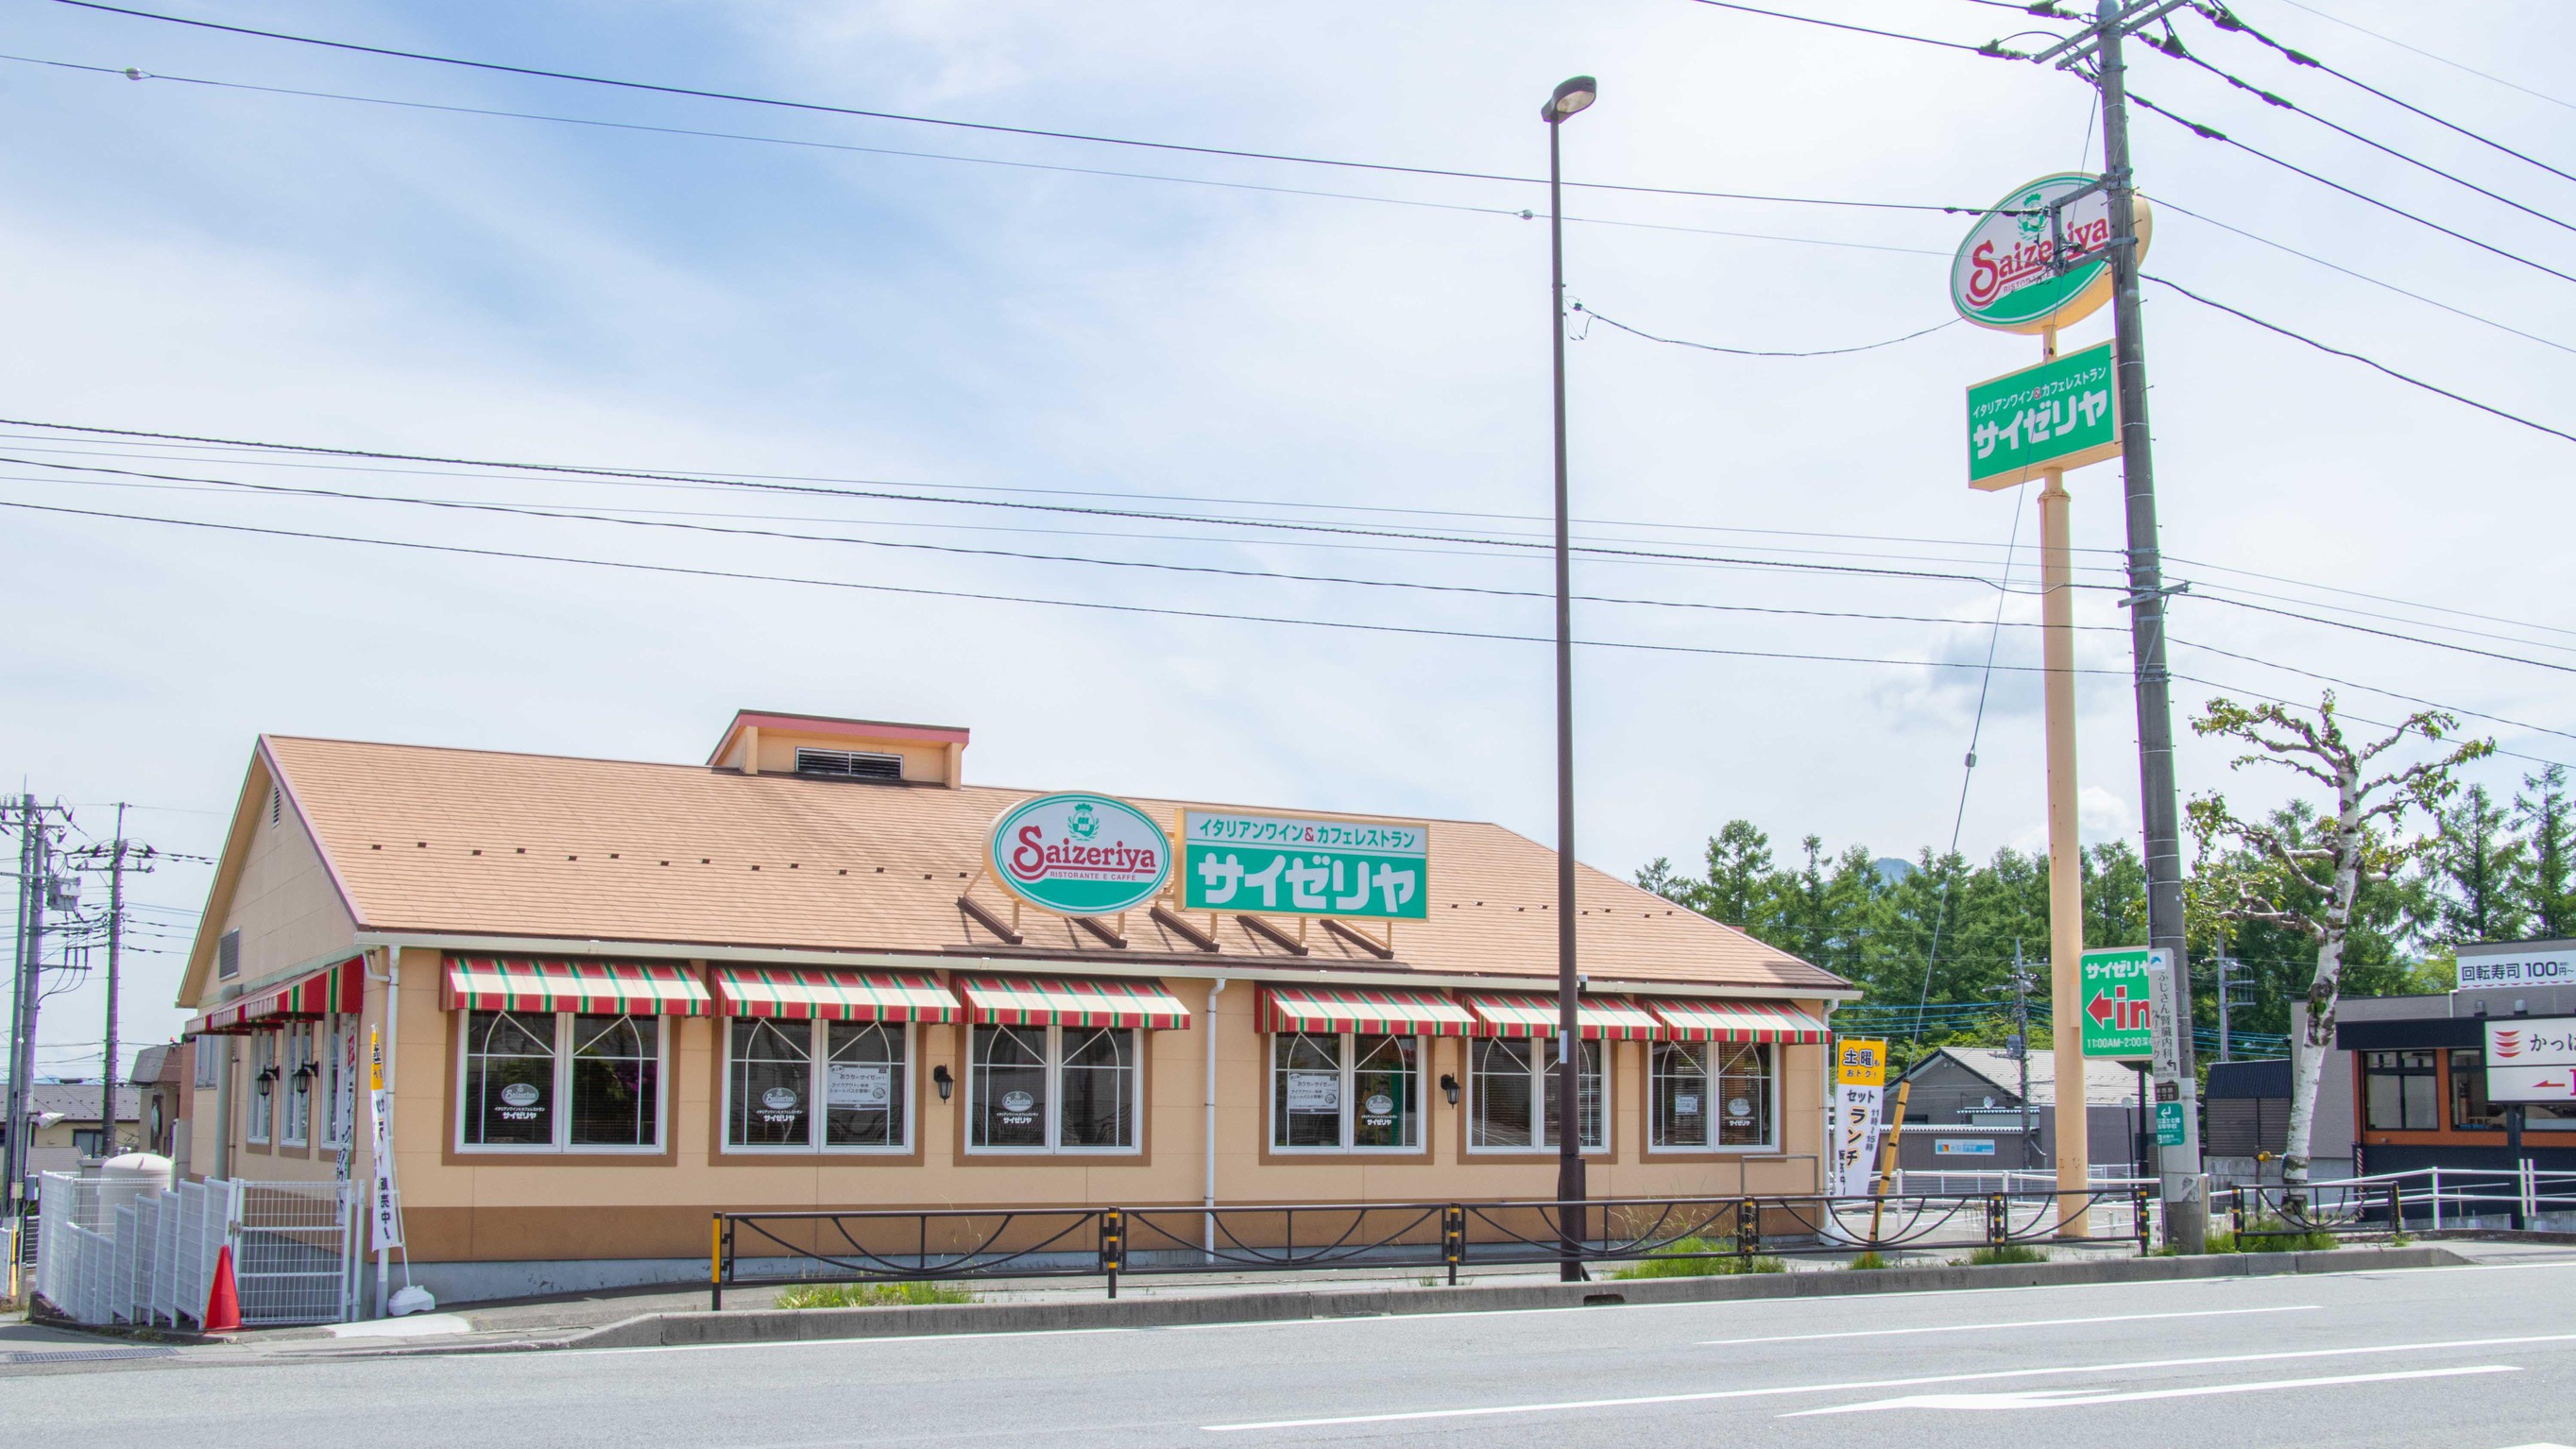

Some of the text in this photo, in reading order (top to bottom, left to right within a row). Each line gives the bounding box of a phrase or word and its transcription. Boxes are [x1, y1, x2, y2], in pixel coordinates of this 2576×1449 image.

[1968, 218, 2108, 303] Saizeiya
[1973, 367, 2107, 418] イタリアンワイン&カフェレストラン
[1973, 389, 2107, 460] サイゼリヤ
[1010, 826, 1156, 878] Saizeriya
[1200, 818, 1415, 848] イタリアンワイン&カフェレストラン
[1050, 871, 1100, 879] RISTORANTE
[1198, 852, 1415, 912] サイゼリヤ
[2462, 963, 2520, 981] 回転寿司
[2115, 985, 2151, 1031] in
[1847, 1089, 1875, 1103] セット
[1846, 1107, 1866, 1167] ランチ
